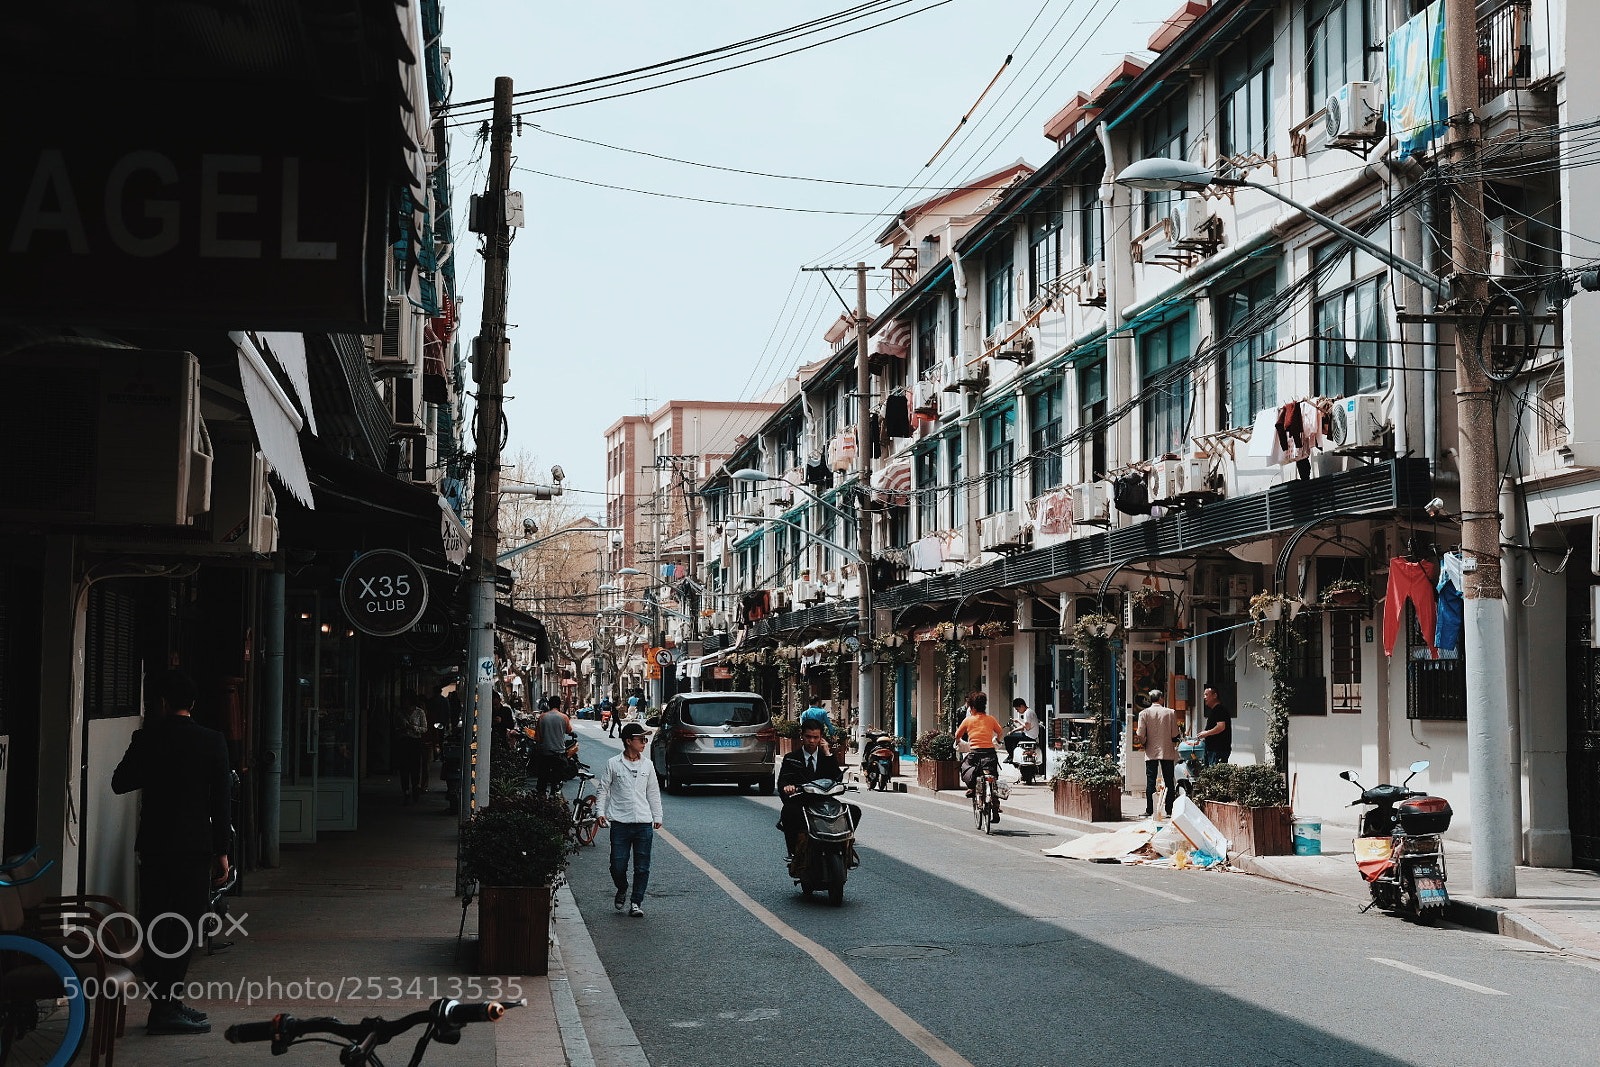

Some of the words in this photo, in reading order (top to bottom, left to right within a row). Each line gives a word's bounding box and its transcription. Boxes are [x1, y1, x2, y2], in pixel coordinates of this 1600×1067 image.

[8, 148, 338, 260] AGEL
[358, 574, 411, 599] X35
[366, 599, 405, 613] CLUB
